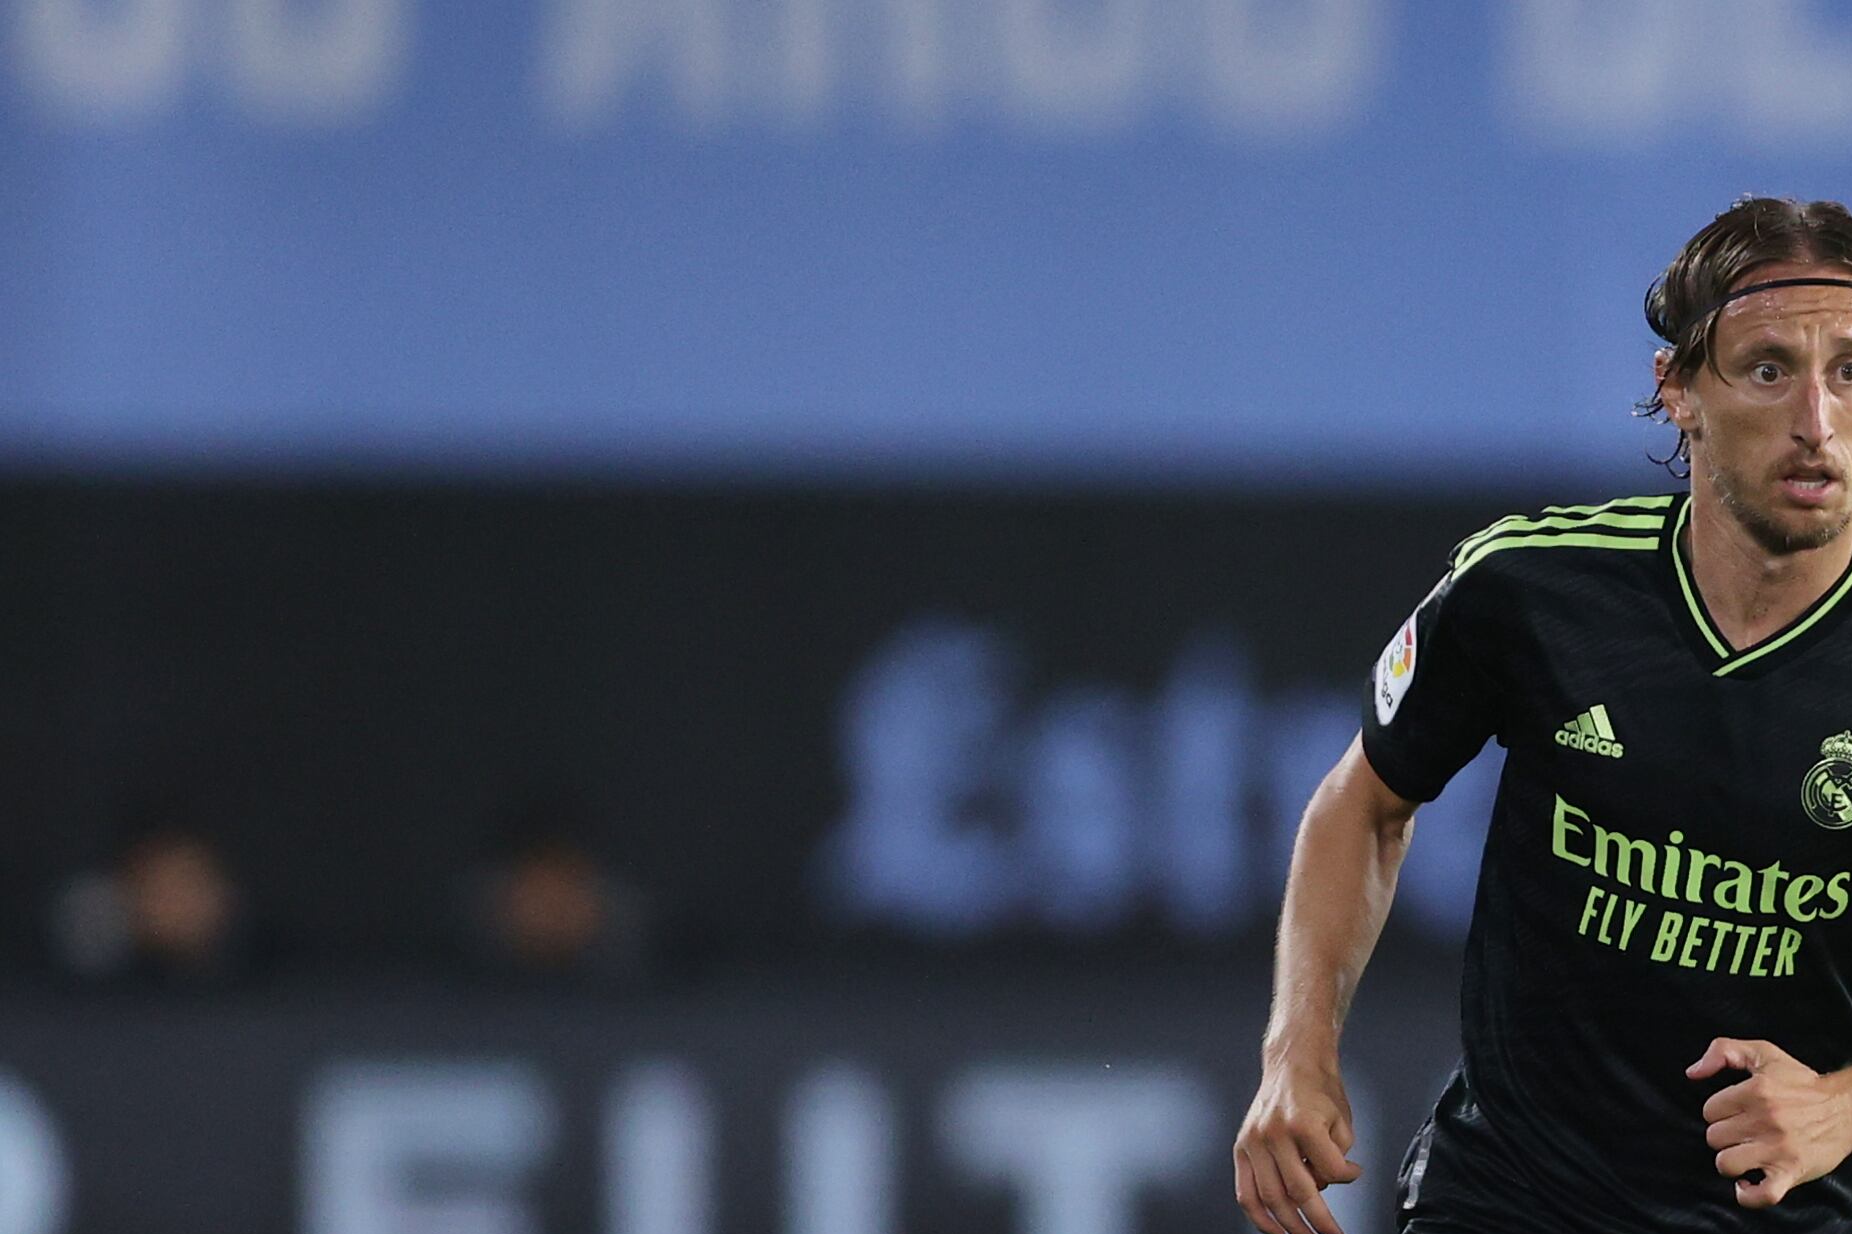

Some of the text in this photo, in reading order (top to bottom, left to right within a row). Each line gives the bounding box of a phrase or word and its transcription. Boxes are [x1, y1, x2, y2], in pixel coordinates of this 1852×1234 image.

[1555, 730, 1624, 758] adidas
[1552, 793, 1850, 922] Emirates
[1578, 886, 1802, 977] FLY BETTER
